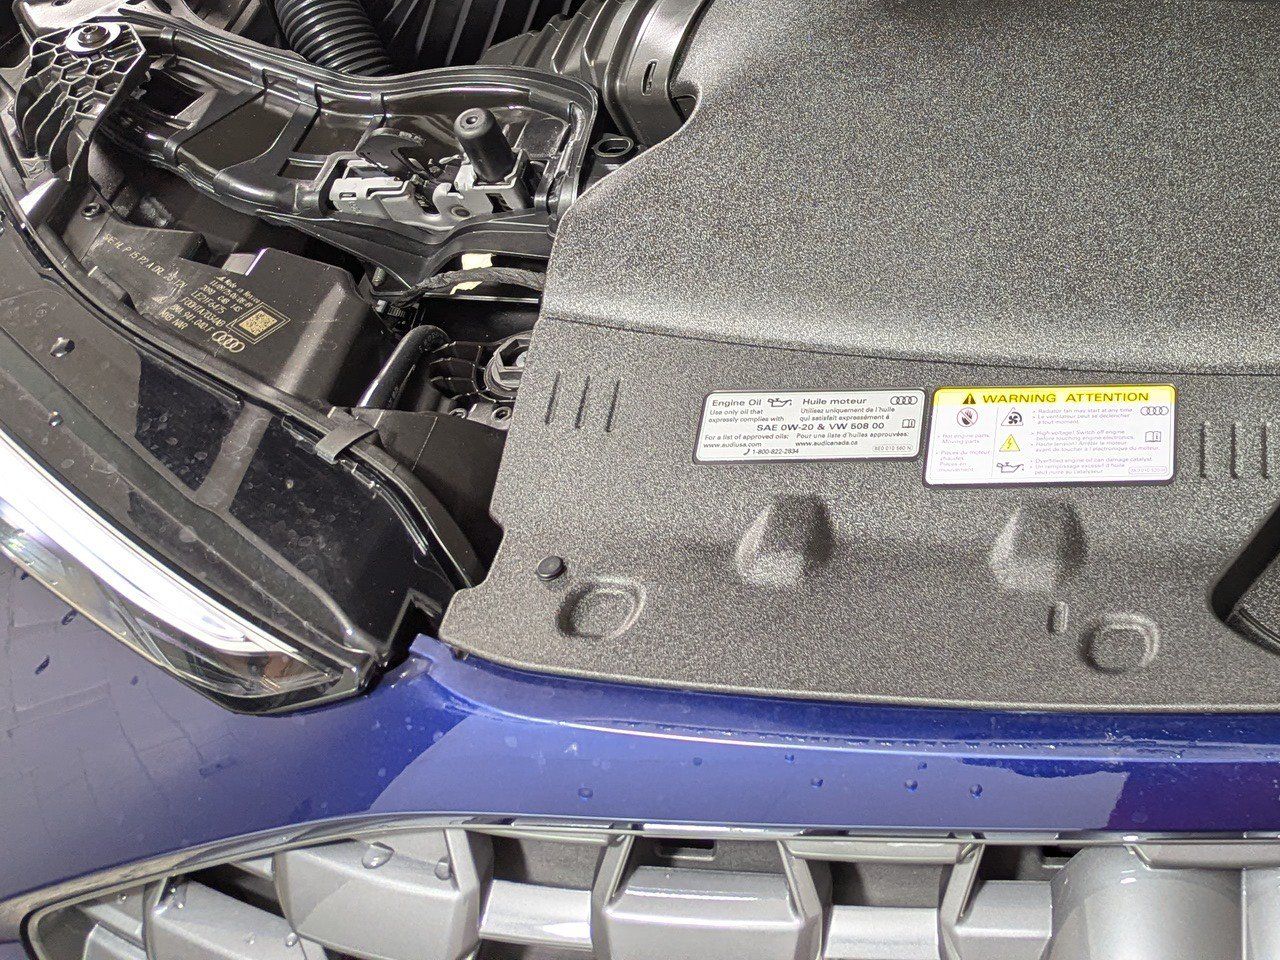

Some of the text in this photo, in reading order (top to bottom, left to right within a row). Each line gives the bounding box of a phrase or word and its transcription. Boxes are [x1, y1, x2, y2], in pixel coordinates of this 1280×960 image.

[983, 392, 1149, 403] WARNING ATTENTION
[712, 399, 745, 407] Engine
